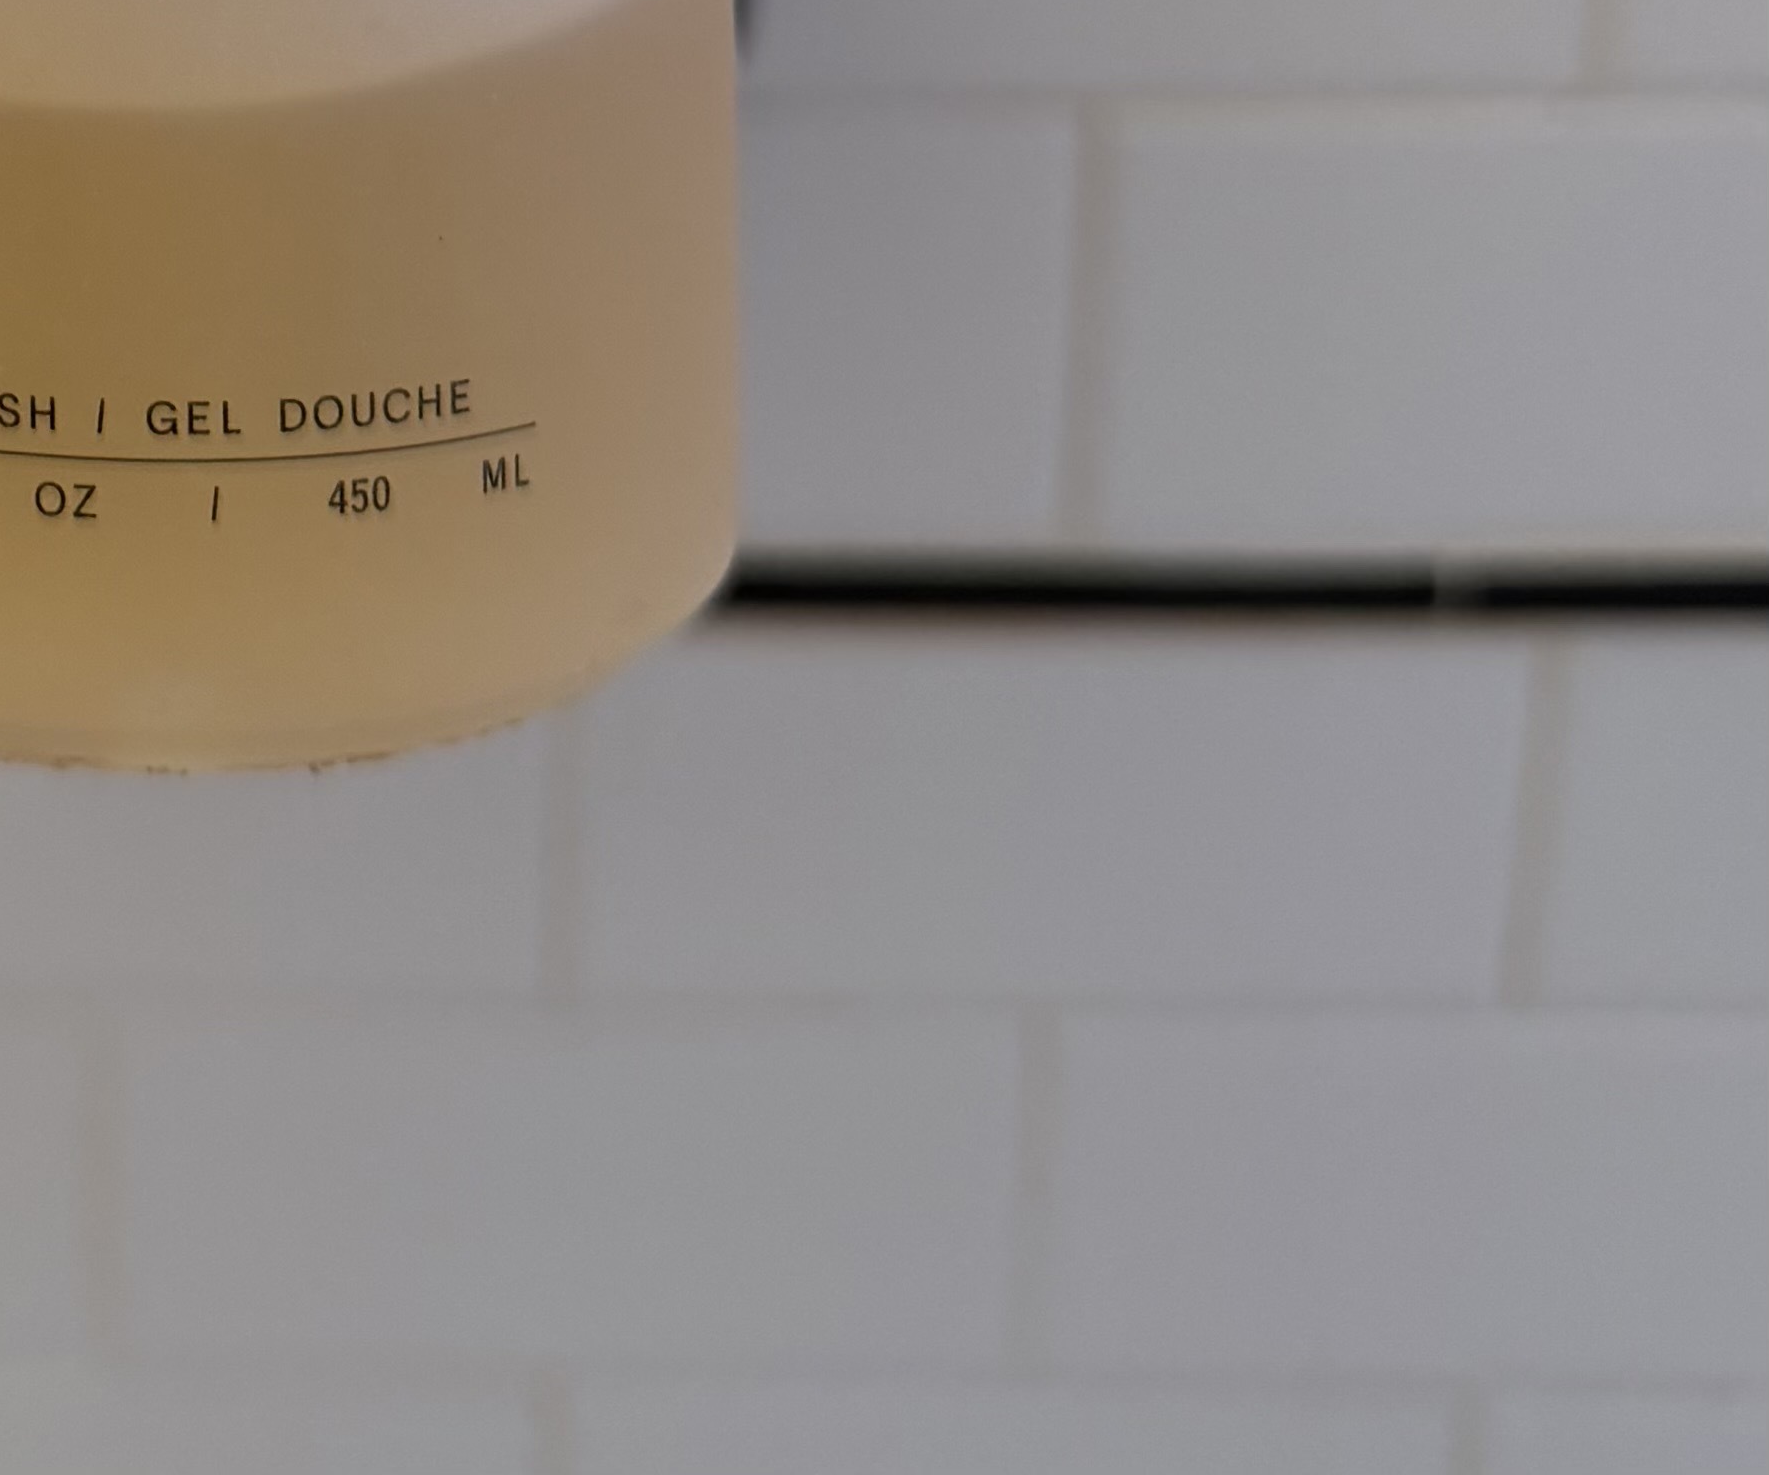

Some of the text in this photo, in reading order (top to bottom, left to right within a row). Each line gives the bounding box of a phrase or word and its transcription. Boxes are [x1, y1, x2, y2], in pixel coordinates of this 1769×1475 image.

[145, 399, 243, 438] GEL
[279, 378, 473, 436] DOUCHE
[34, 480, 99, 521] OZ
[327, 475, 392, 517] 450
[482, 453, 532, 496] ML
